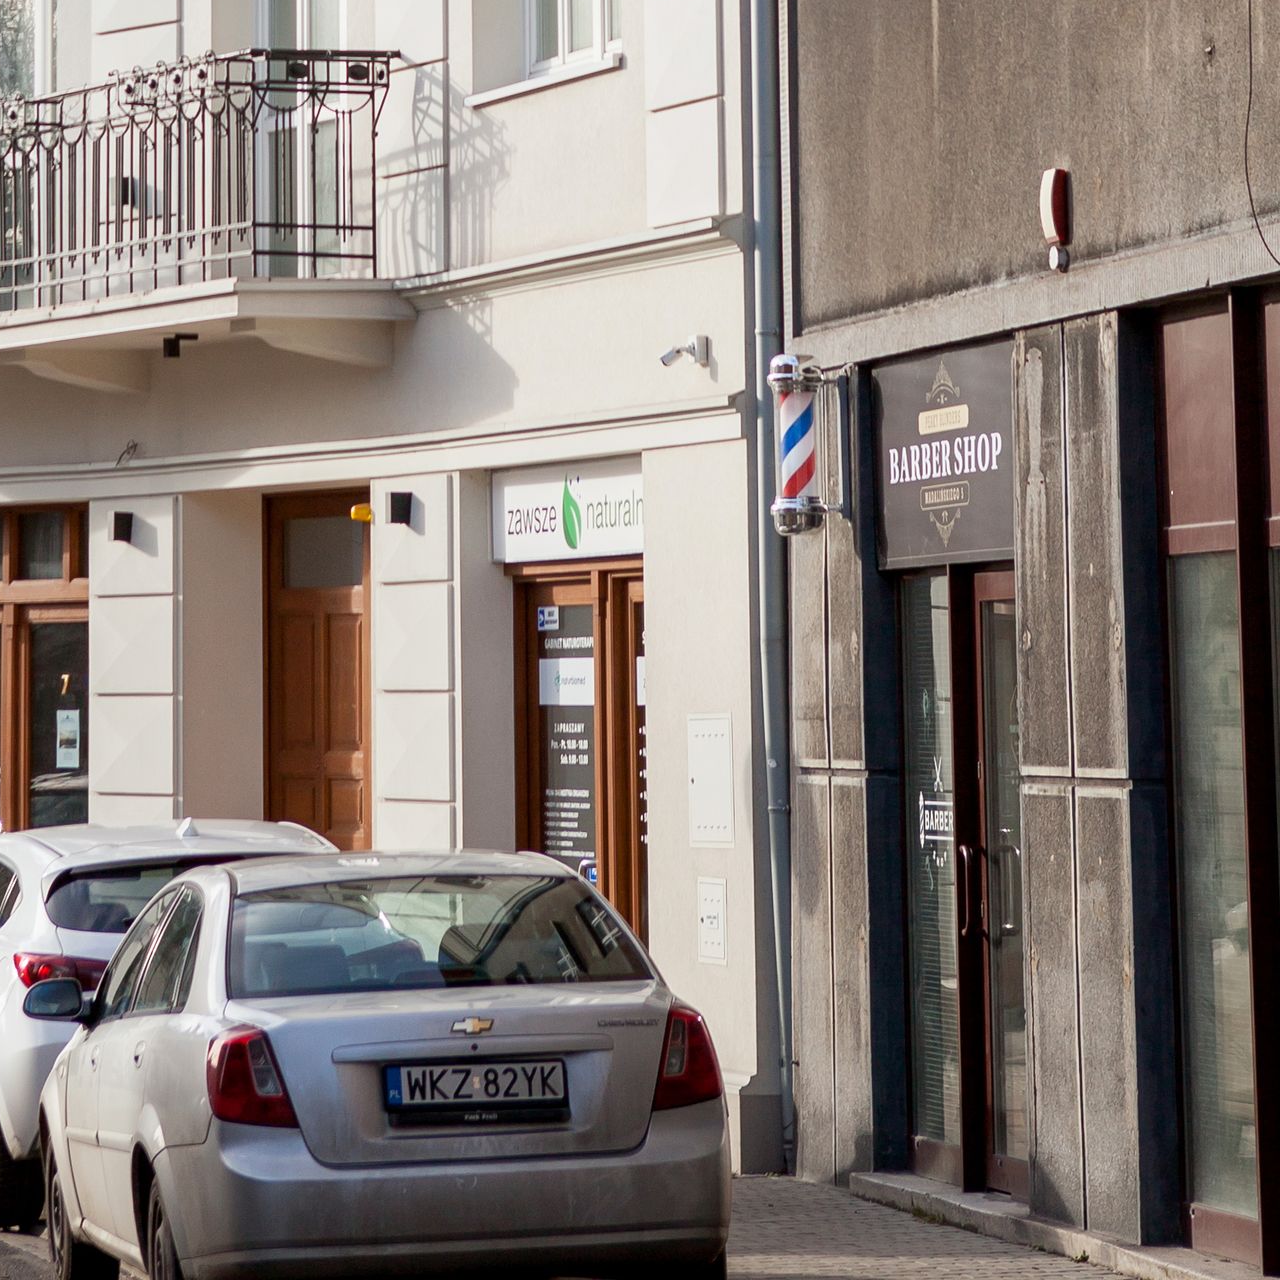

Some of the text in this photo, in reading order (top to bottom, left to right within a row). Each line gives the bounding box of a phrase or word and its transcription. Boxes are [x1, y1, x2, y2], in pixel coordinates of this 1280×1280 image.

[889, 432, 1002, 484] BARBER SHOP
[507, 505, 557, 535] zawsze
[553, 723, 584, 733] ZAPRASZAMY
[925, 810, 953, 831] BARBER
[389, 1089, 401, 1099] PL
[406, 1065, 560, 1101] WKZ 82YK
